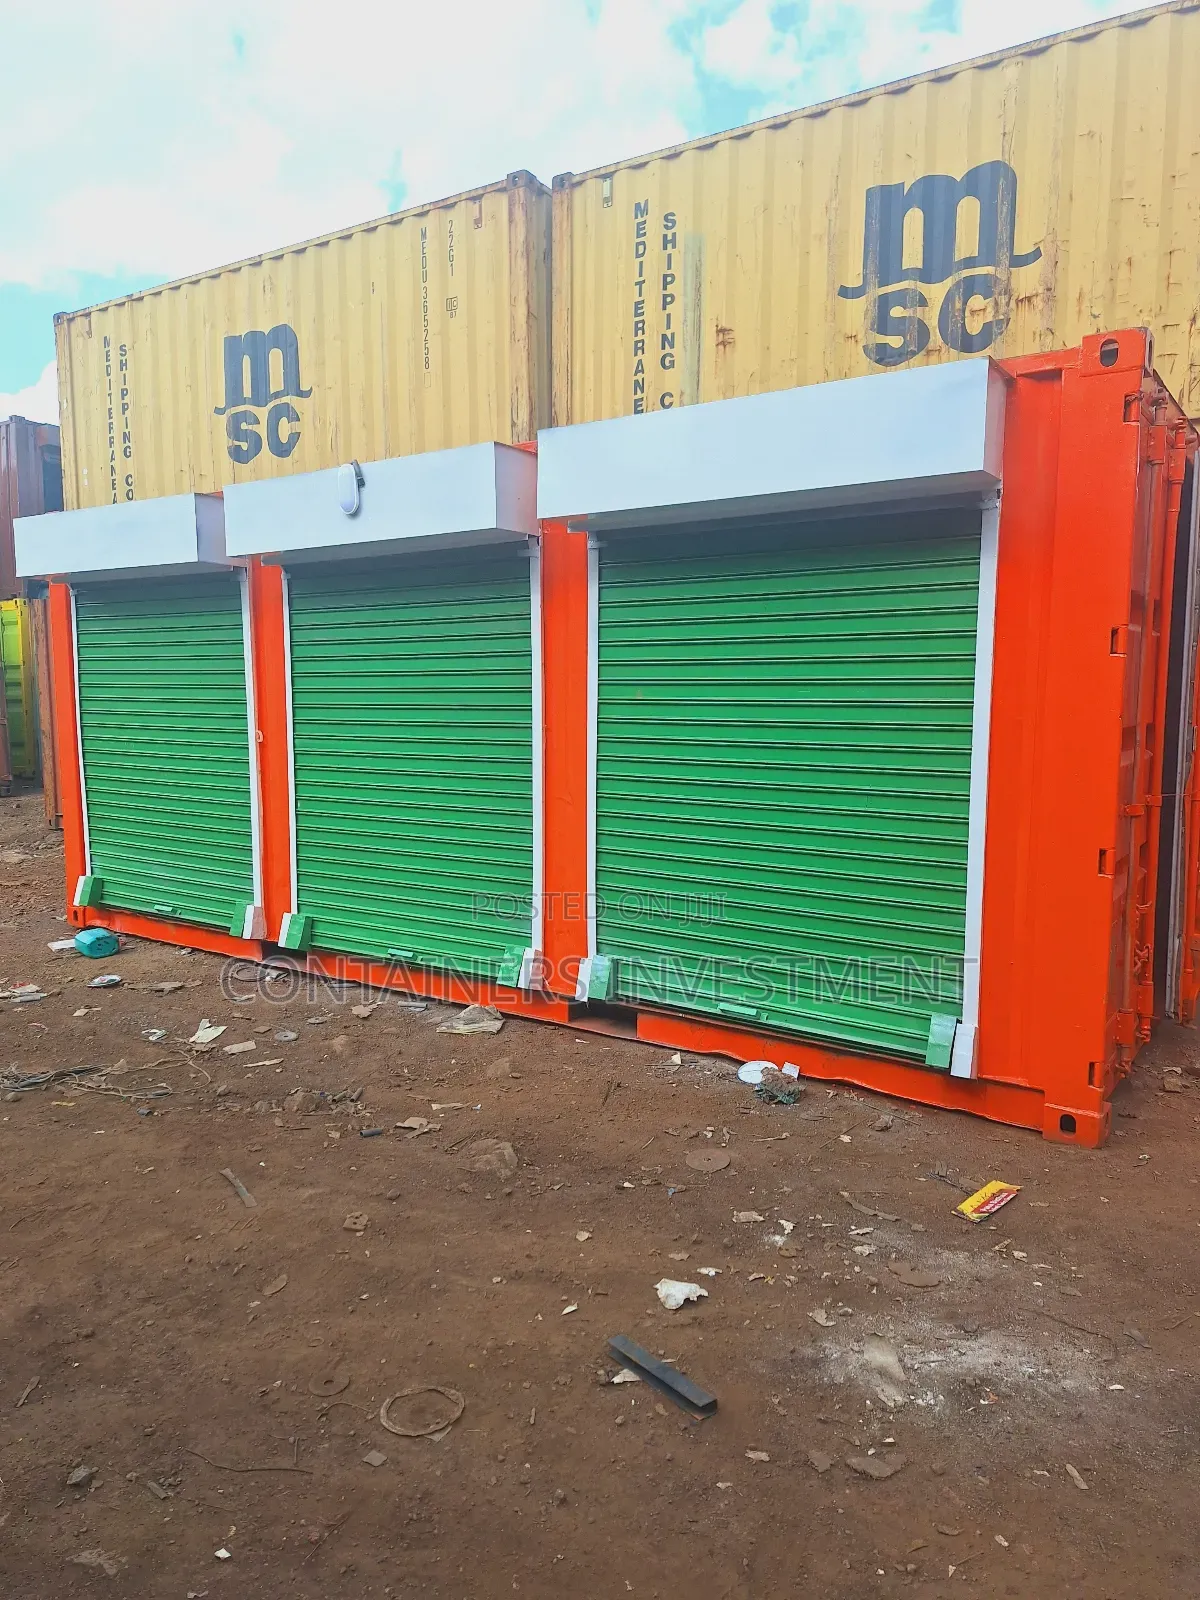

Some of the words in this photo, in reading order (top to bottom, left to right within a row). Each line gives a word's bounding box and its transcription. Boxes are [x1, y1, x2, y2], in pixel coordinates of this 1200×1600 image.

[659, 211, 677, 371] SHIPPING
[119, 344, 132, 459] SHIPPING
[125, 473, 134, 501] CO
